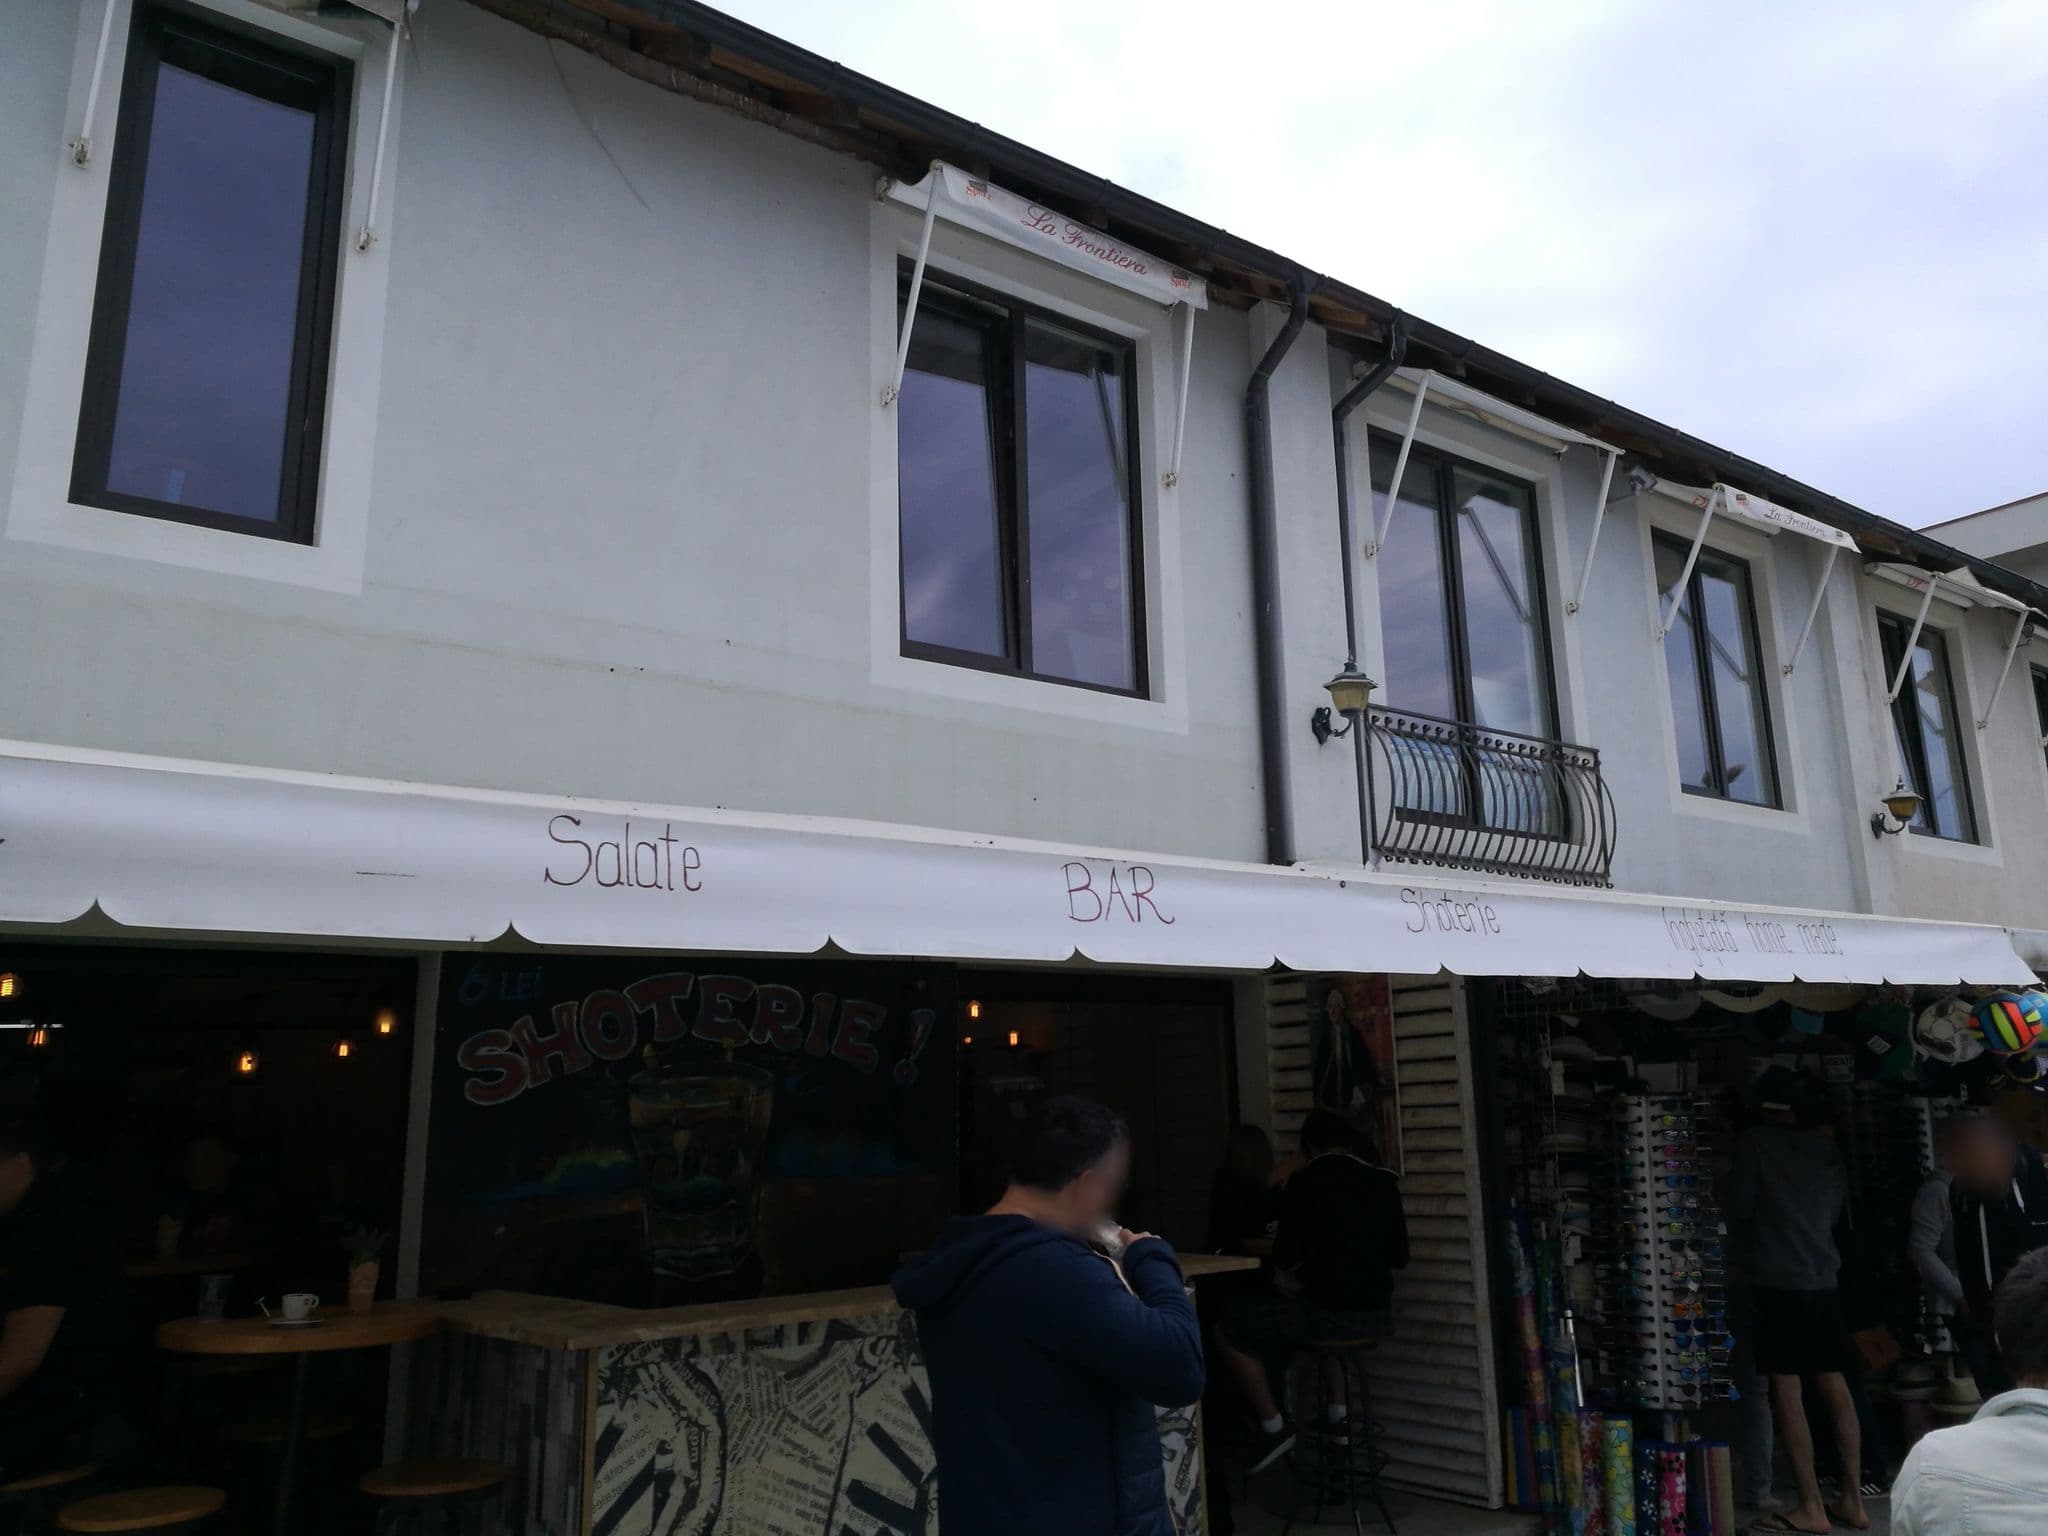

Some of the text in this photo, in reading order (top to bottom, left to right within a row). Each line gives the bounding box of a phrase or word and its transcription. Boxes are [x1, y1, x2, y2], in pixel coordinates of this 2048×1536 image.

[1021, 205, 1147, 276] La Frontiera
[544, 814, 702, 892] Salate
[1061, 862, 1175, 925] BAR
[1400, 887, 1500, 936] Shoterie
[458, 960, 488, 1007] 6
